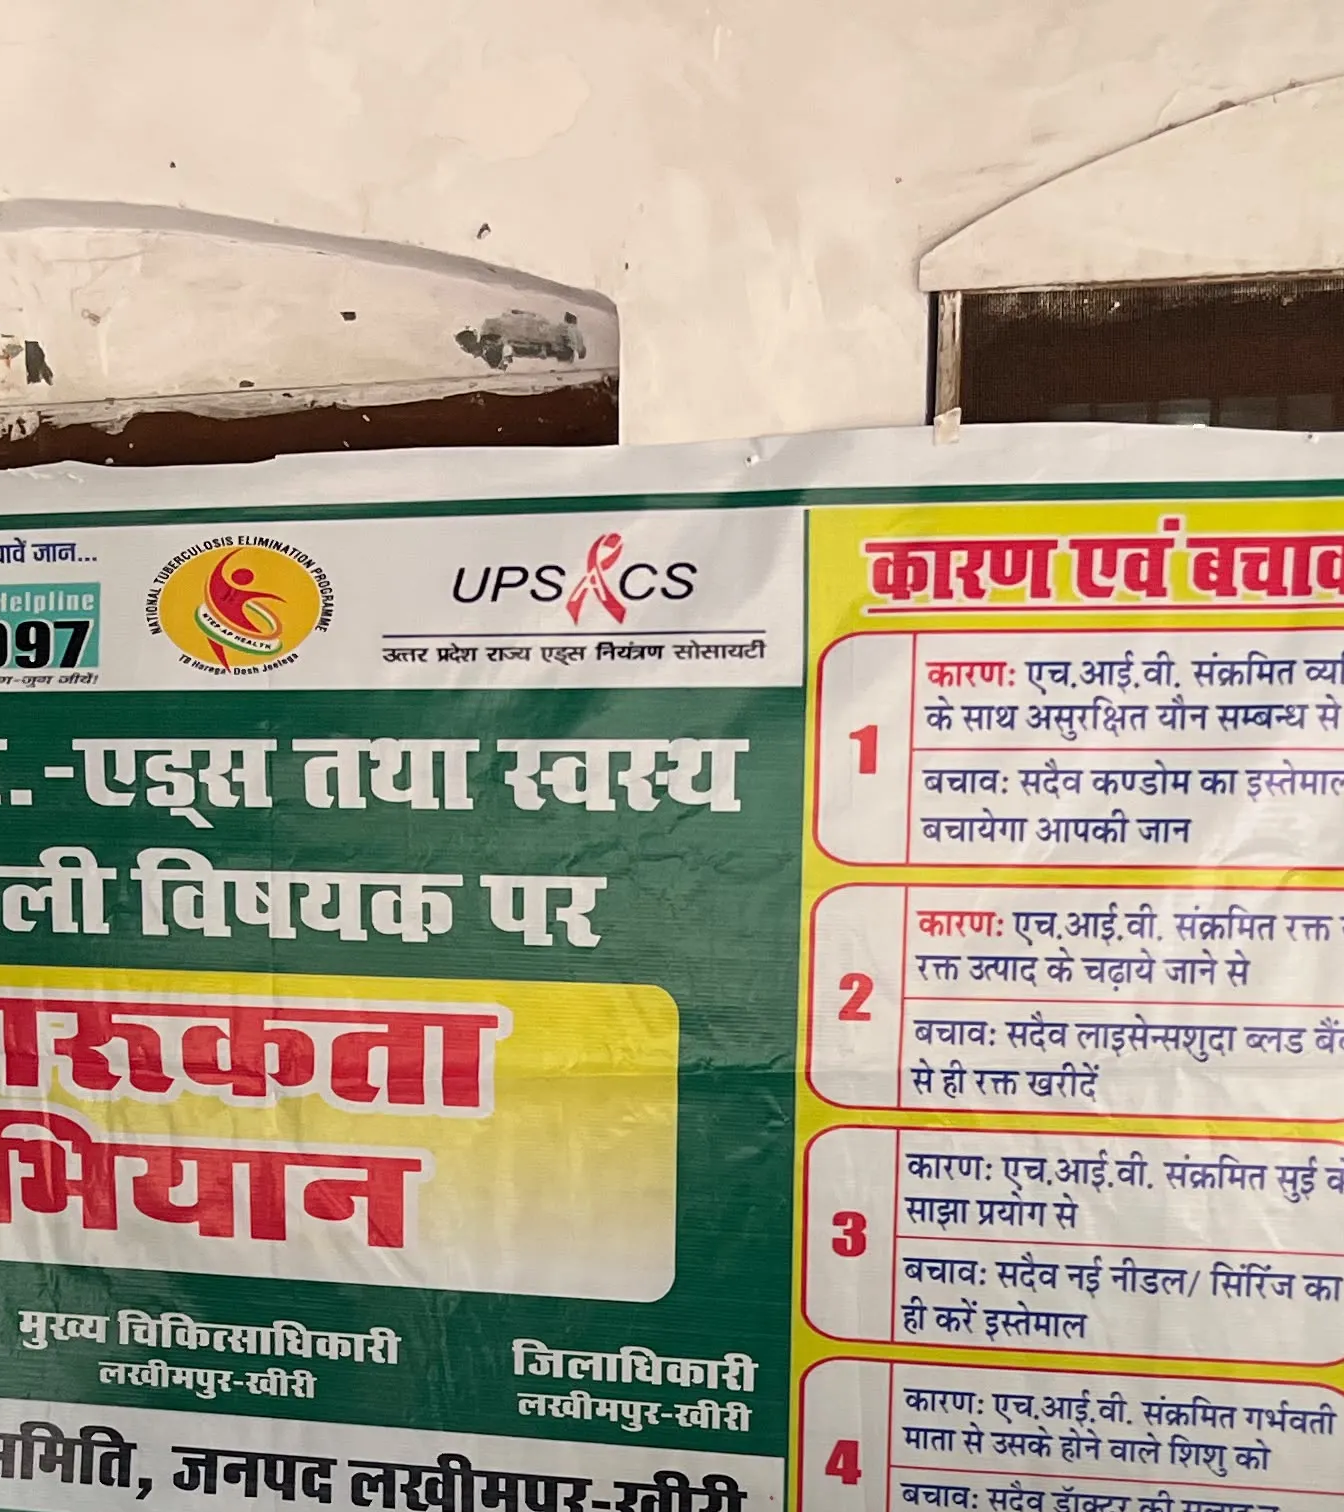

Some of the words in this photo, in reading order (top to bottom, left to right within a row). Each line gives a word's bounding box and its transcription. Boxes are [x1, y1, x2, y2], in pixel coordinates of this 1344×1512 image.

[153, 536, 234, 585] TUBERCULOSIS
[238, 535, 316, 569] ELIMINATION
[865, 536, 1059, 600] कारण
[1069, 518, 1182, 599] एवं
[311, 567, 336, 633] PROGRAMME
[452, 561, 698, 604] UPSACS
[145, 588, 162, 635] NATIONAL
[382, 646, 429, 663] उत्तर
[436, 641, 479, 663] प्रदेश
[485, 645, 530, 663] राज्य
[595, 640, 664, 662] नियंत्रण
[673, 639, 766, 661] सोसायटी
[925, 661, 1017, 688] कारण:
[1024, 650, 1181, 696] एच.आई.वी.
[1191, 651, 1298, 688] संक्रमित
[924, 695, 955, 731] के
[961, 705, 1019, 732] साथ
[1026, 695, 1150, 742] असुरक्षित
[1156, 693, 1210, 731] यौन
[1216, 704, 1309, 732] सम्बन्ध
[1316, 693, 1343, 732] से
[849, 724, 878, 775] 1
[292, 736, 481, 811] तथा
[497, 736, 750, 813] स्वस्थ
[922, 769, 1009, 794] बचाव:
[1018, 758, 1084, 799] सदैव
[1090, 759, 1193, 796] कण्डोम
[1198, 769, 1239, 795] का
[920, 807, 1029, 843] बचायेगा
[1036, 808, 1130, 844] आपकी
[1136, 818, 1193, 844] जान
[130, 847, 464, 943] विषयक
[480, 874, 608, 949] पर
[916, 910, 1004, 938] कारण:
[1012, 902, 1163, 946] एच.आई.वी.
[1173, 903, 1277, 941] संक्रमित
[1283, 915, 1334, 943] रक्त
[915, 955, 962, 981] रक्त
[967, 956, 1039, 987] उत्पाद
[1044, 946, 1075, 983] के
[1081, 947, 1156, 992] चढ़ाये
[1163, 948, 1218, 986] जाने
[1225, 949, 1251, 988] से
[837, 972, 874, 1021] 2
[913, 1019, 996, 1047] बचाव:
[1004, 1010, 1070, 1053] सदैव
[1074, 1013, 1238, 1063] लाइसेन्सशुदा
[1243, 1026, 1307, 1054] ब्लड
[910, 1058, 936, 1095] से
[941, 1059, 967, 1099] ही
[973, 1069, 1020, 1096] रक्त
[1025, 1061, 1100, 1102] खरीदें
[905, 1153, 993, 1181] कारण:
[1001, 1149, 1153, 1193] एच.आई.वी.
[1163, 1153, 1268, 1190] संक्रमित
[1275, 1155, 1318, 1204] सुई
[832, 1211, 868, 1257] 3
[904, 1197, 970, 1231] साझा
[976, 1190, 1048, 1227] प्रयोग
[1053, 1192, 1080, 1230] से
[902, 1257, 987, 1286] बचाव:
[995, 1251, 1060, 1293] सदैव
[1065, 1255, 1104, 1299] नई
[1302, 1274, 1344, 1302] का
[19, 1309, 110, 1350] मुख्य
[118, 1309, 403, 1366] चिकित्साधिकारी
[900, 1295, 928, 1335] ही
[933, 1297, 978, 1334] करें
[983, 1300, 1088, 1342] इस्तेमाल
[98, 1357, 318, 1400] लखीमपुर-खीरी
[512, 1337, 758, 1393] जिलाधिकारी
[517, 1391, 752, 1433] लखीमपुर-खीरी
[903, 1388, 984, 1415] कारण:
[992, 1388, 1132, 1427] एच.आई.वी.
[1141, 1395, 1237, 1430] संक्रमित
[1243, 1399, 1338, 1436] गर्भवती
[824, 1440, 863, 1485] 4
[902, 1426, 957, 1452] माता
[961, 1421, 985, 1455] से
[990, 1425, 1054, 1458] उसके
[1059, 1427, 1102, 1463] होने
[1107, 1432, 1162, 1465] वाले
[1168, 1433, 1228, 1478] शिशु
[1233, 1438, 1272, 1471] को
[171, 1444, 338, 1505] जनपद
[900, 1482, 978, 1510] बचाव:
